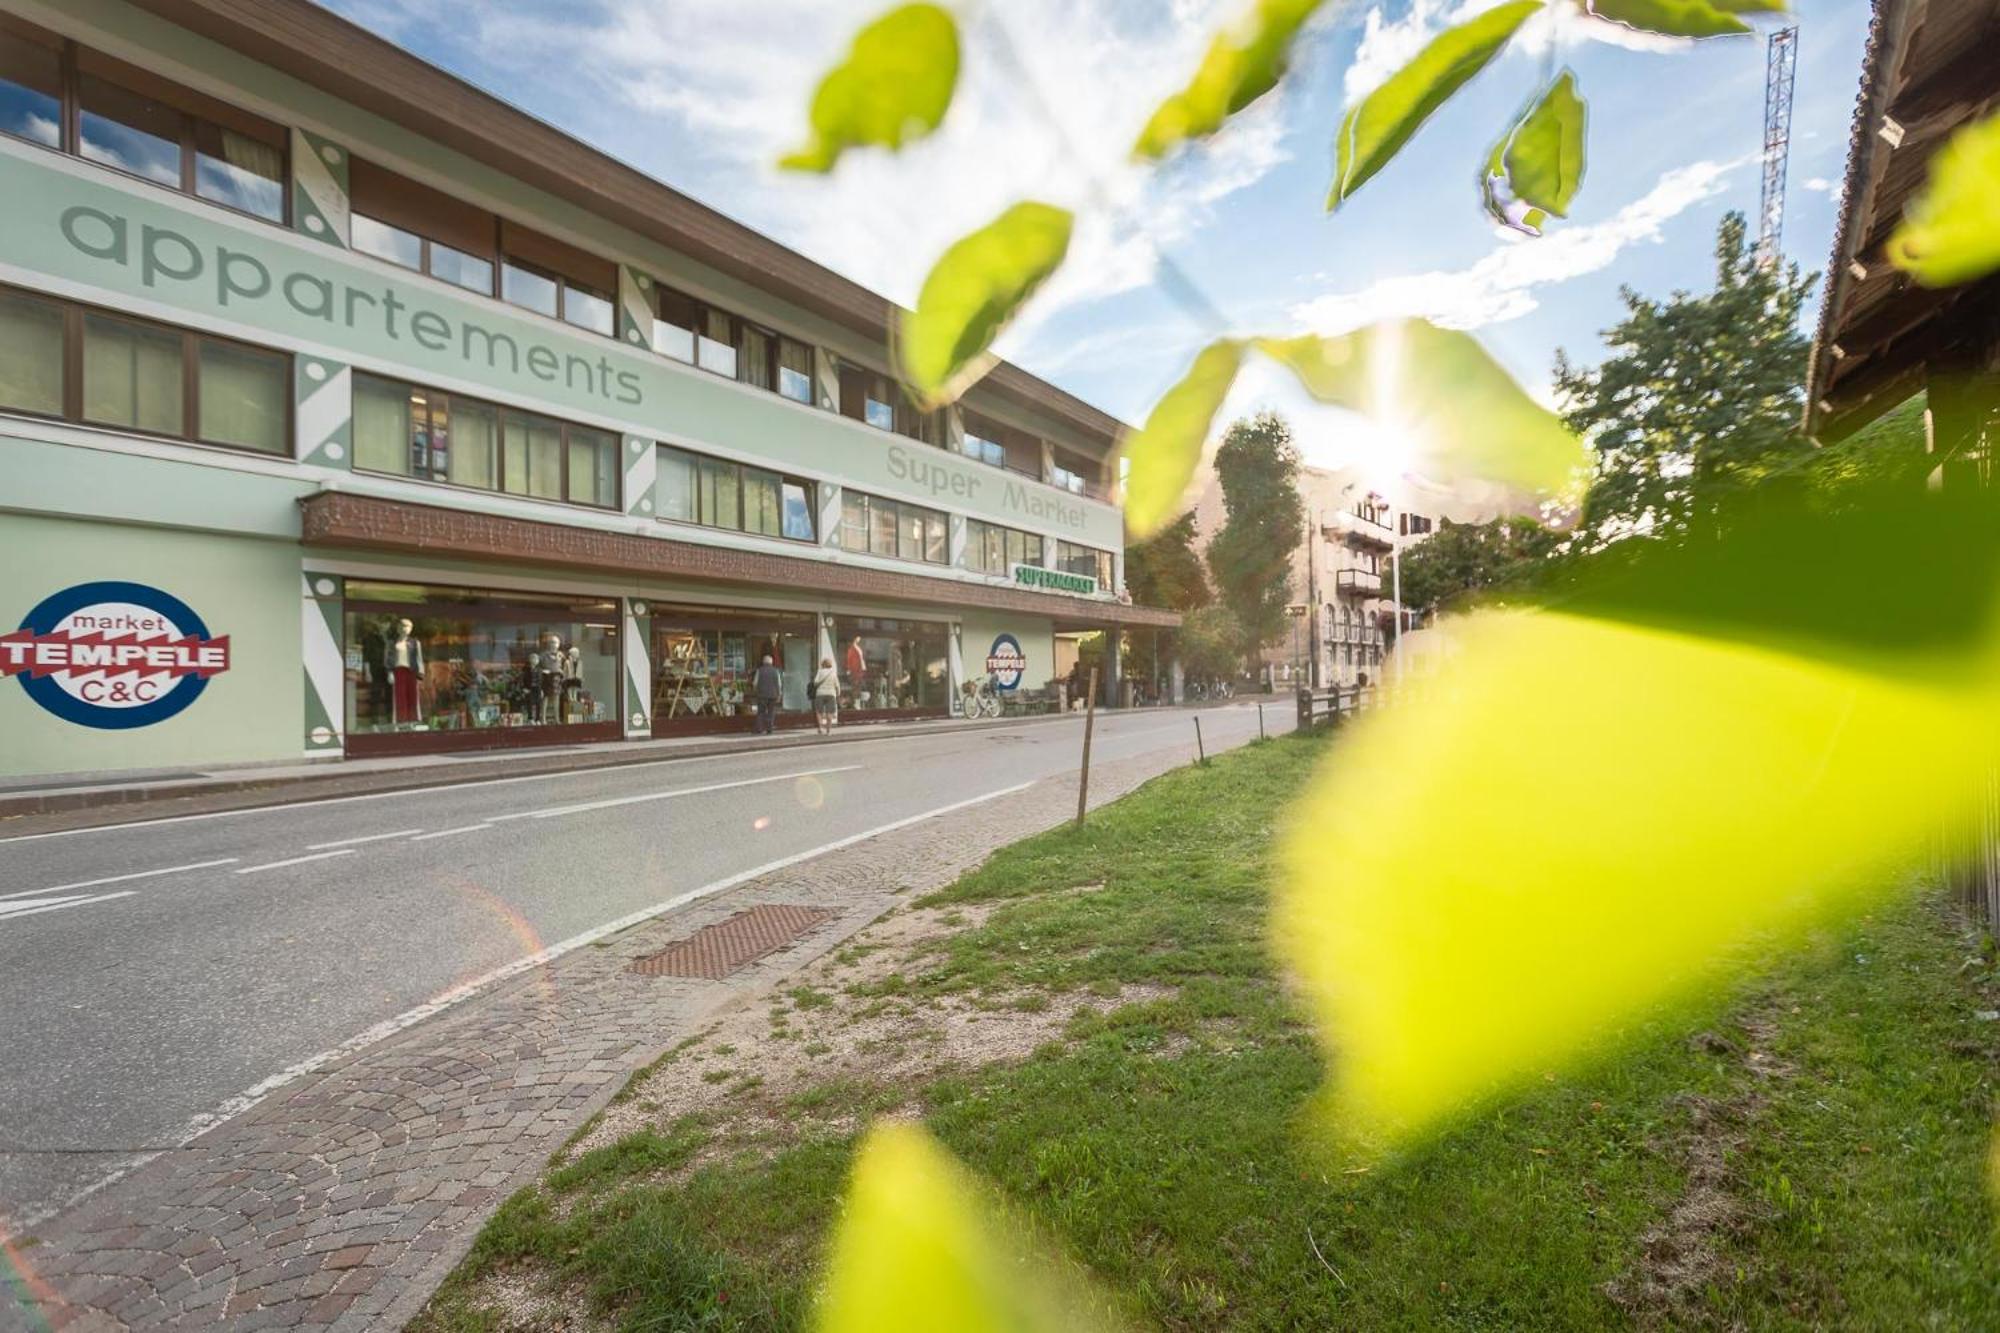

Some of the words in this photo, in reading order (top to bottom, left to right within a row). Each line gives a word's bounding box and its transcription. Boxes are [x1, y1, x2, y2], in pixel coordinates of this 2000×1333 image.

[59, 205, 643, 405] appartements
[886, 446, 982, 498] Super
[1002, 480, 1088, 529] Market
[72, 614, 166, 631] market
[1, 642, 225, 668] TEMPELE
[80, 680, 157, 702] C&C
